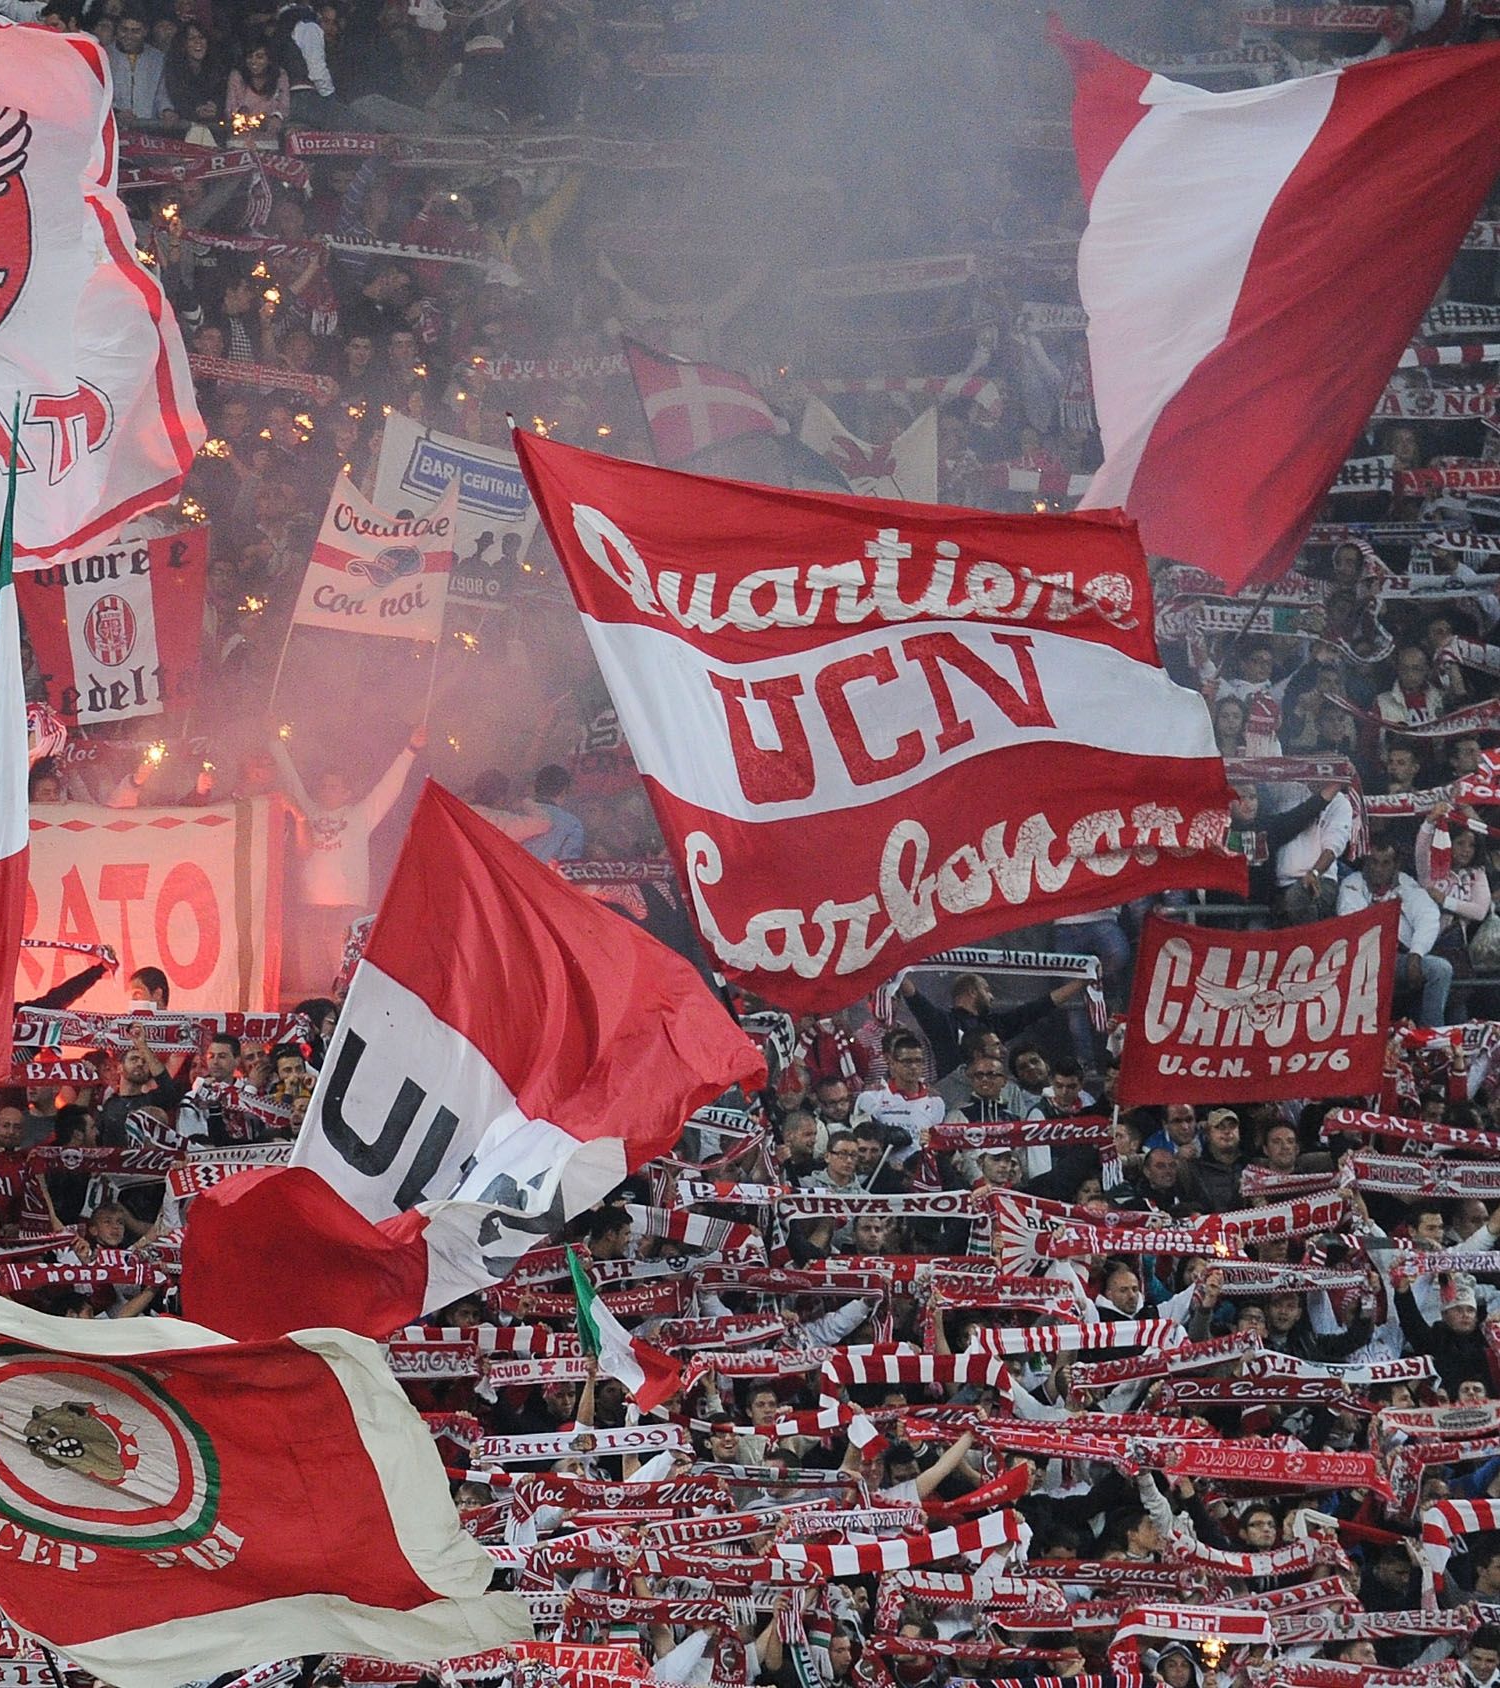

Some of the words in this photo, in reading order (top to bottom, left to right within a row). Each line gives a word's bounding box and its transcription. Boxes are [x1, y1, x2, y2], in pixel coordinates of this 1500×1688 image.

[706, 631, 1057, 806] UCN
[1143, 924, 1384, 1050] CANOSA
[1157, 1053, 1251, 1078] U.C.N.
[1268, 1048, 1351, 1076] 1976
[778, 1198, 892, 1218] CURVA
[47, 1266, 109, 1284] NORD
[1172, 1380, 1221, 1399] Del
[1229, 1381, 1289, 1399] Bari
[1194, 1449, 1276, 1471] MAGICO
[1316, 1459, 1367, 1475] BARI
[656, 1481, 730, 1505] Ultra
[1144, 1613, 1172, 1629] as
[1176, 1613, 1221, 1633] bari
